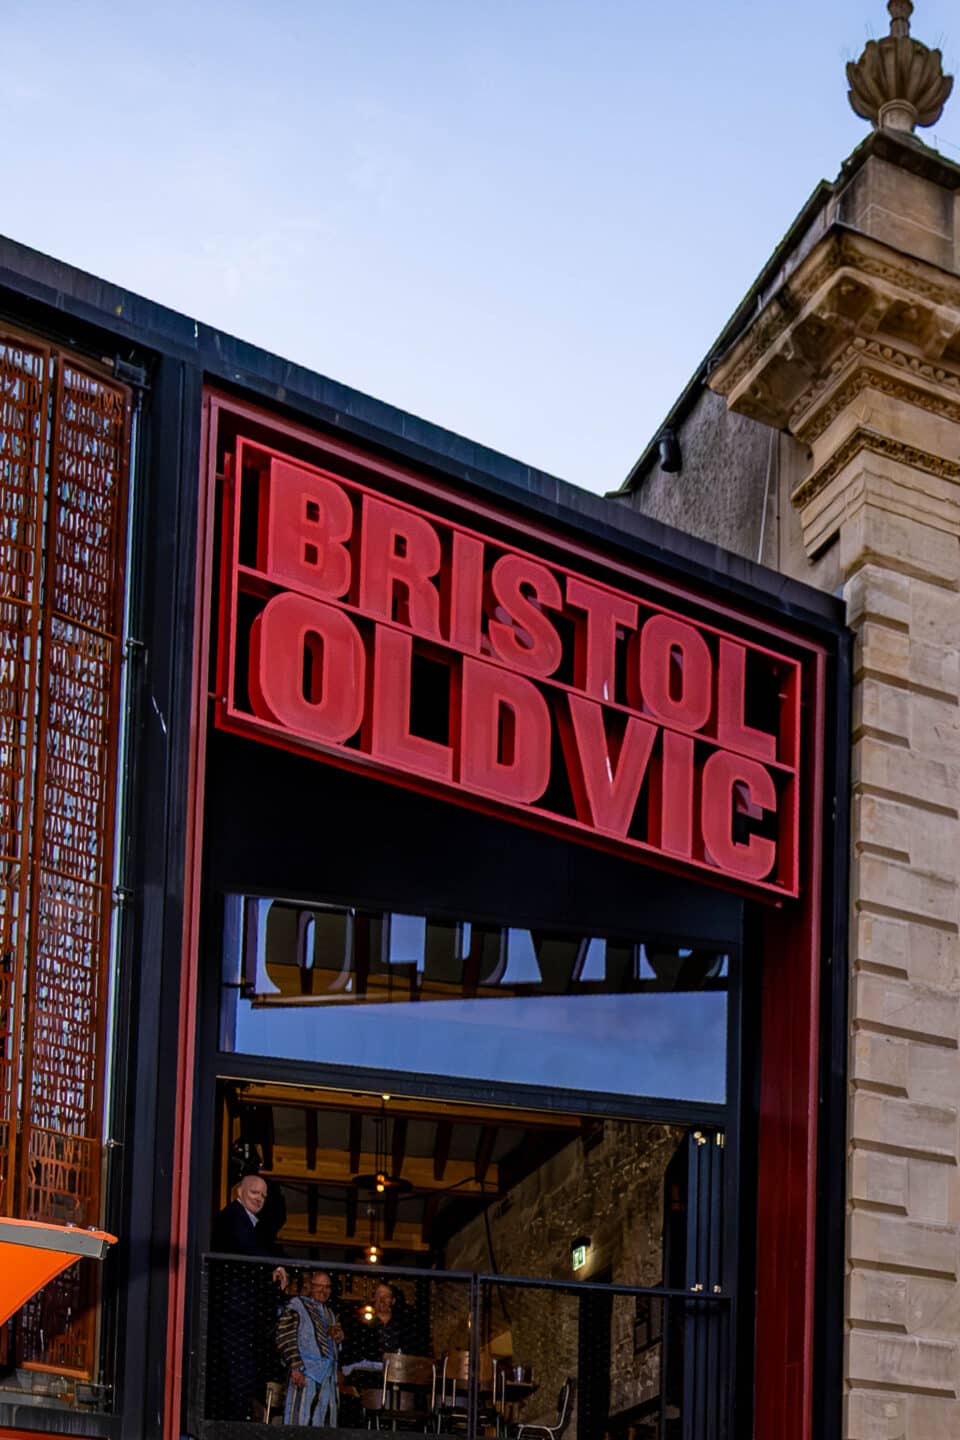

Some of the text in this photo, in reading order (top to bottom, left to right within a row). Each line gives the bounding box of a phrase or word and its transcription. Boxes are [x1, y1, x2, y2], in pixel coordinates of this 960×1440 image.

[255, 590, 777, 881] OLD VIC
[265, 455, 778, 763] BRISTOL
